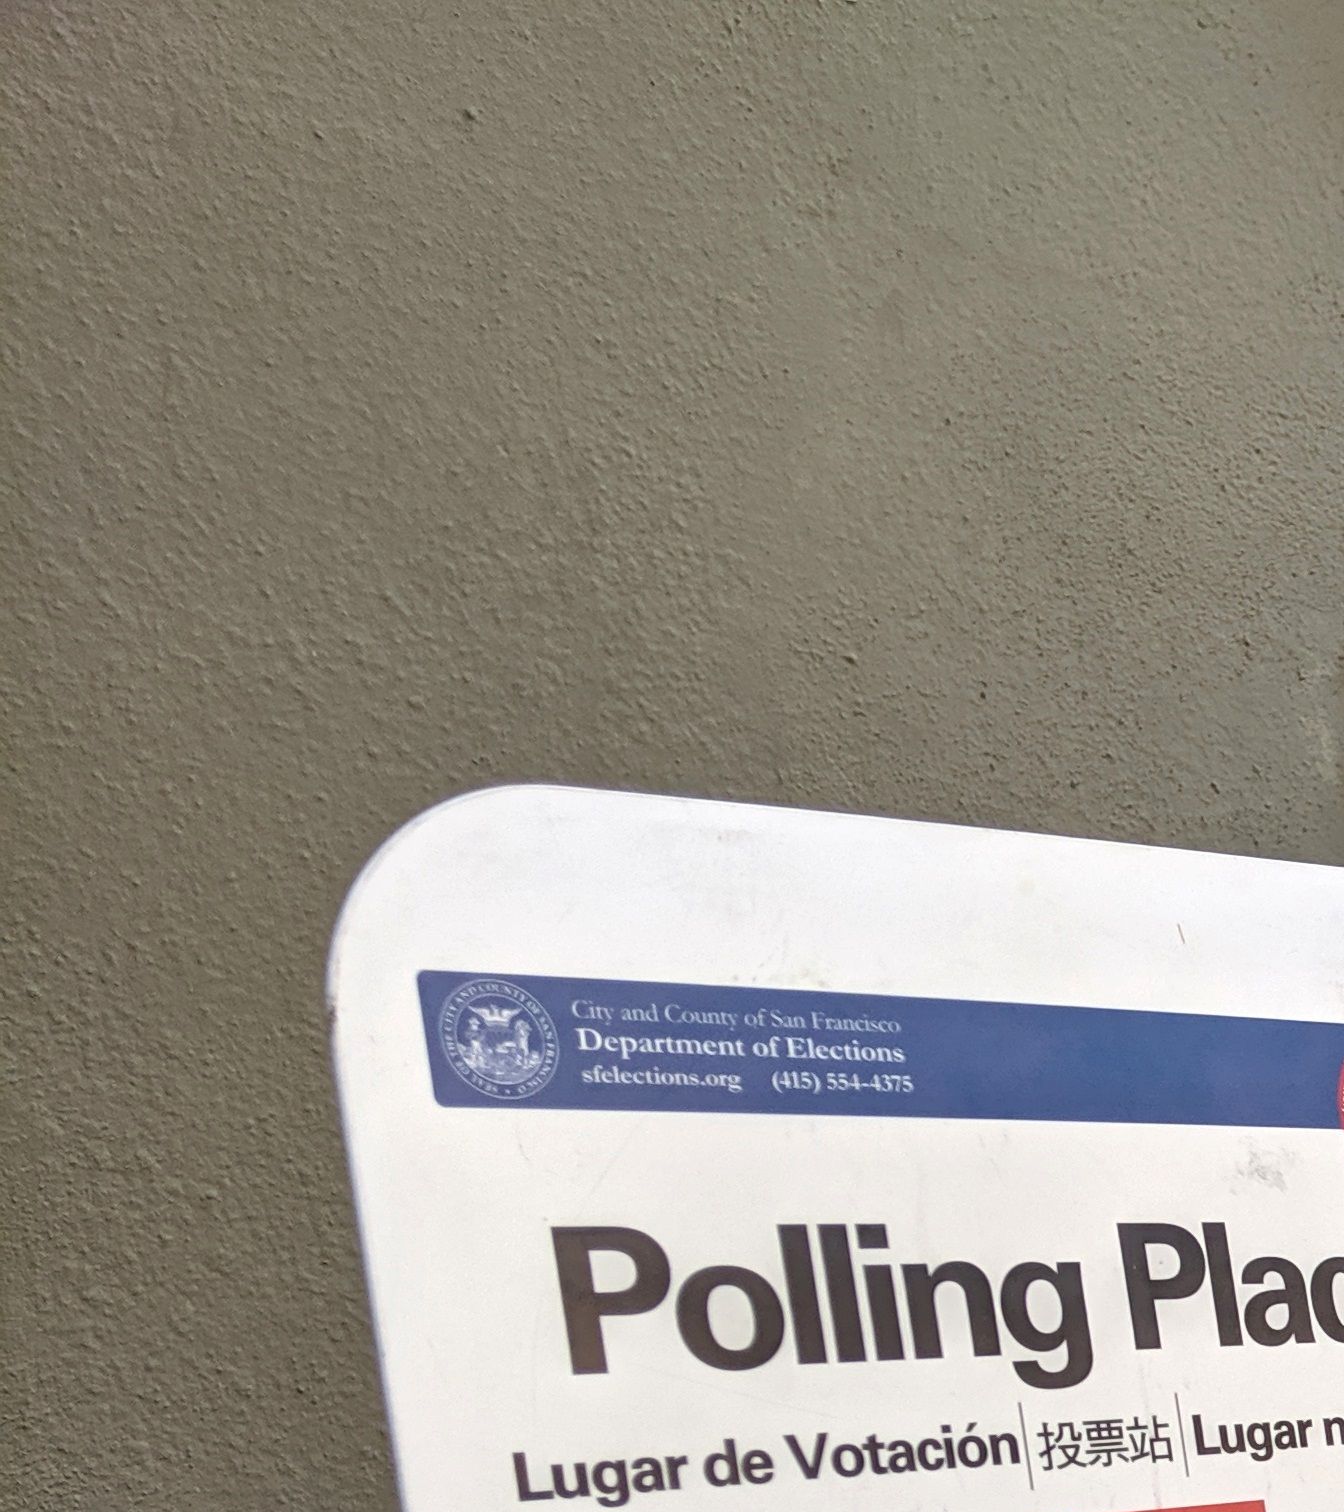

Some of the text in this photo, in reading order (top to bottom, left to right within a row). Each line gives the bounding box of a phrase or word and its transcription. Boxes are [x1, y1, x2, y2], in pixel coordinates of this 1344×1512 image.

[571, 999, 901, 1033] City and County of San Francisco
[577, 1028, 905, 1063] Department of Elections
[582, 1064, 914, 1093] sfelections.org (415) 554-4375
[551, 1223, 1093, 1388] Polling
[1039, 1417, 1174, 1471] 投票站
[1193, 1414, 1312, 1462] Lugar
[513, 1422, 1020, 1508] Lugar de Votación
